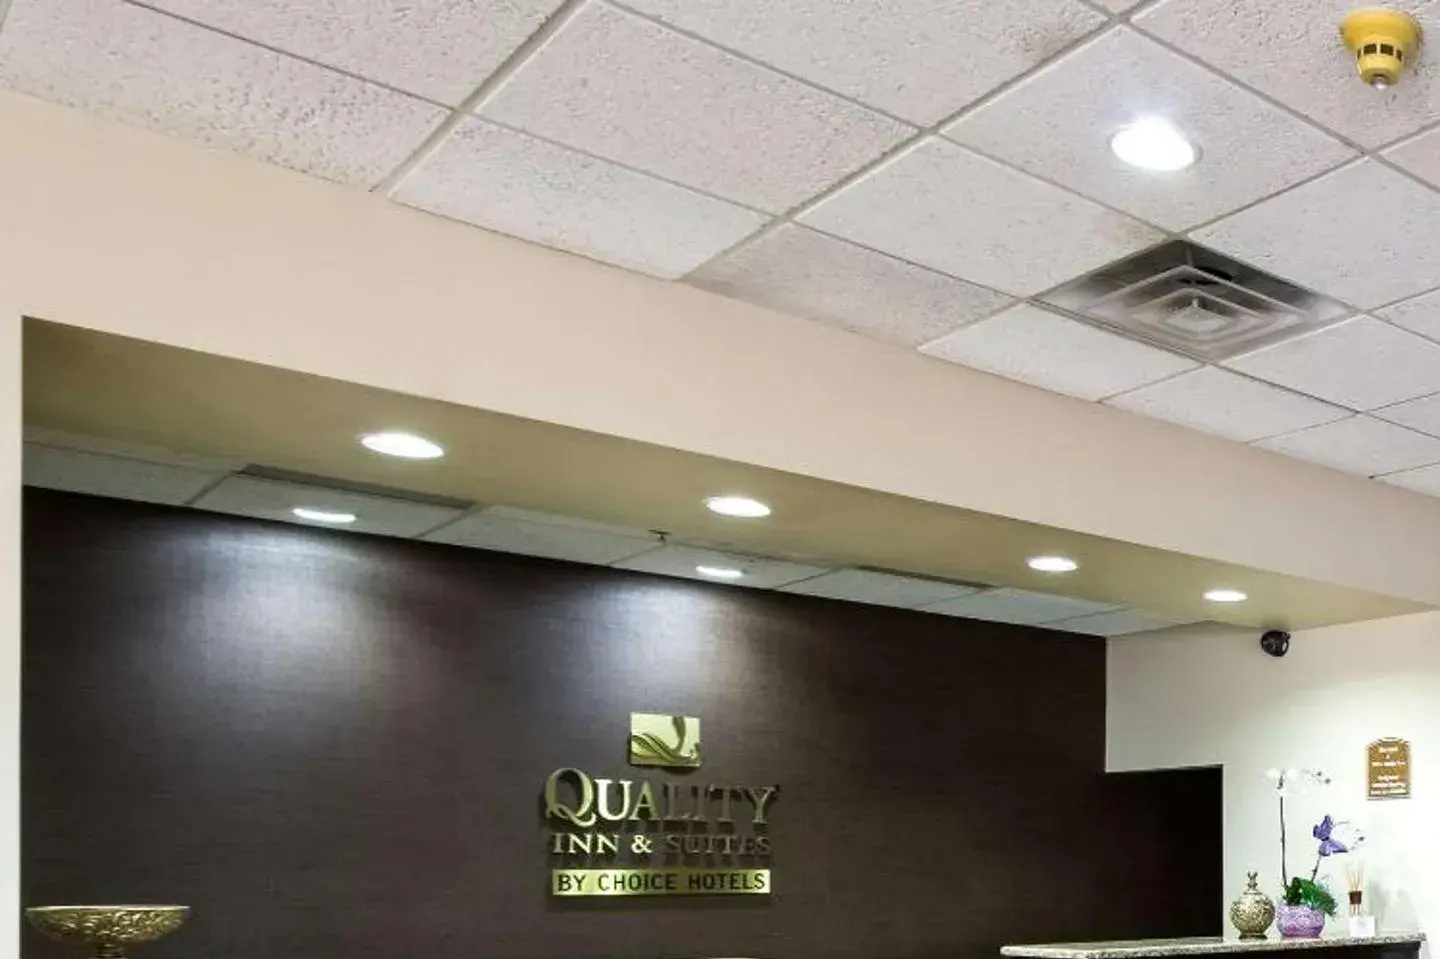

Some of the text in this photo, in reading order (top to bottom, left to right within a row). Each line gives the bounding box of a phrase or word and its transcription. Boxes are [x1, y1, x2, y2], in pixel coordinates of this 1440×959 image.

[544, 767, 777, 827] QUALITY
[552, 832, 771, 855] INN & SUITES
[557, 872, 766, 891] BY CHOICE HOTELS
